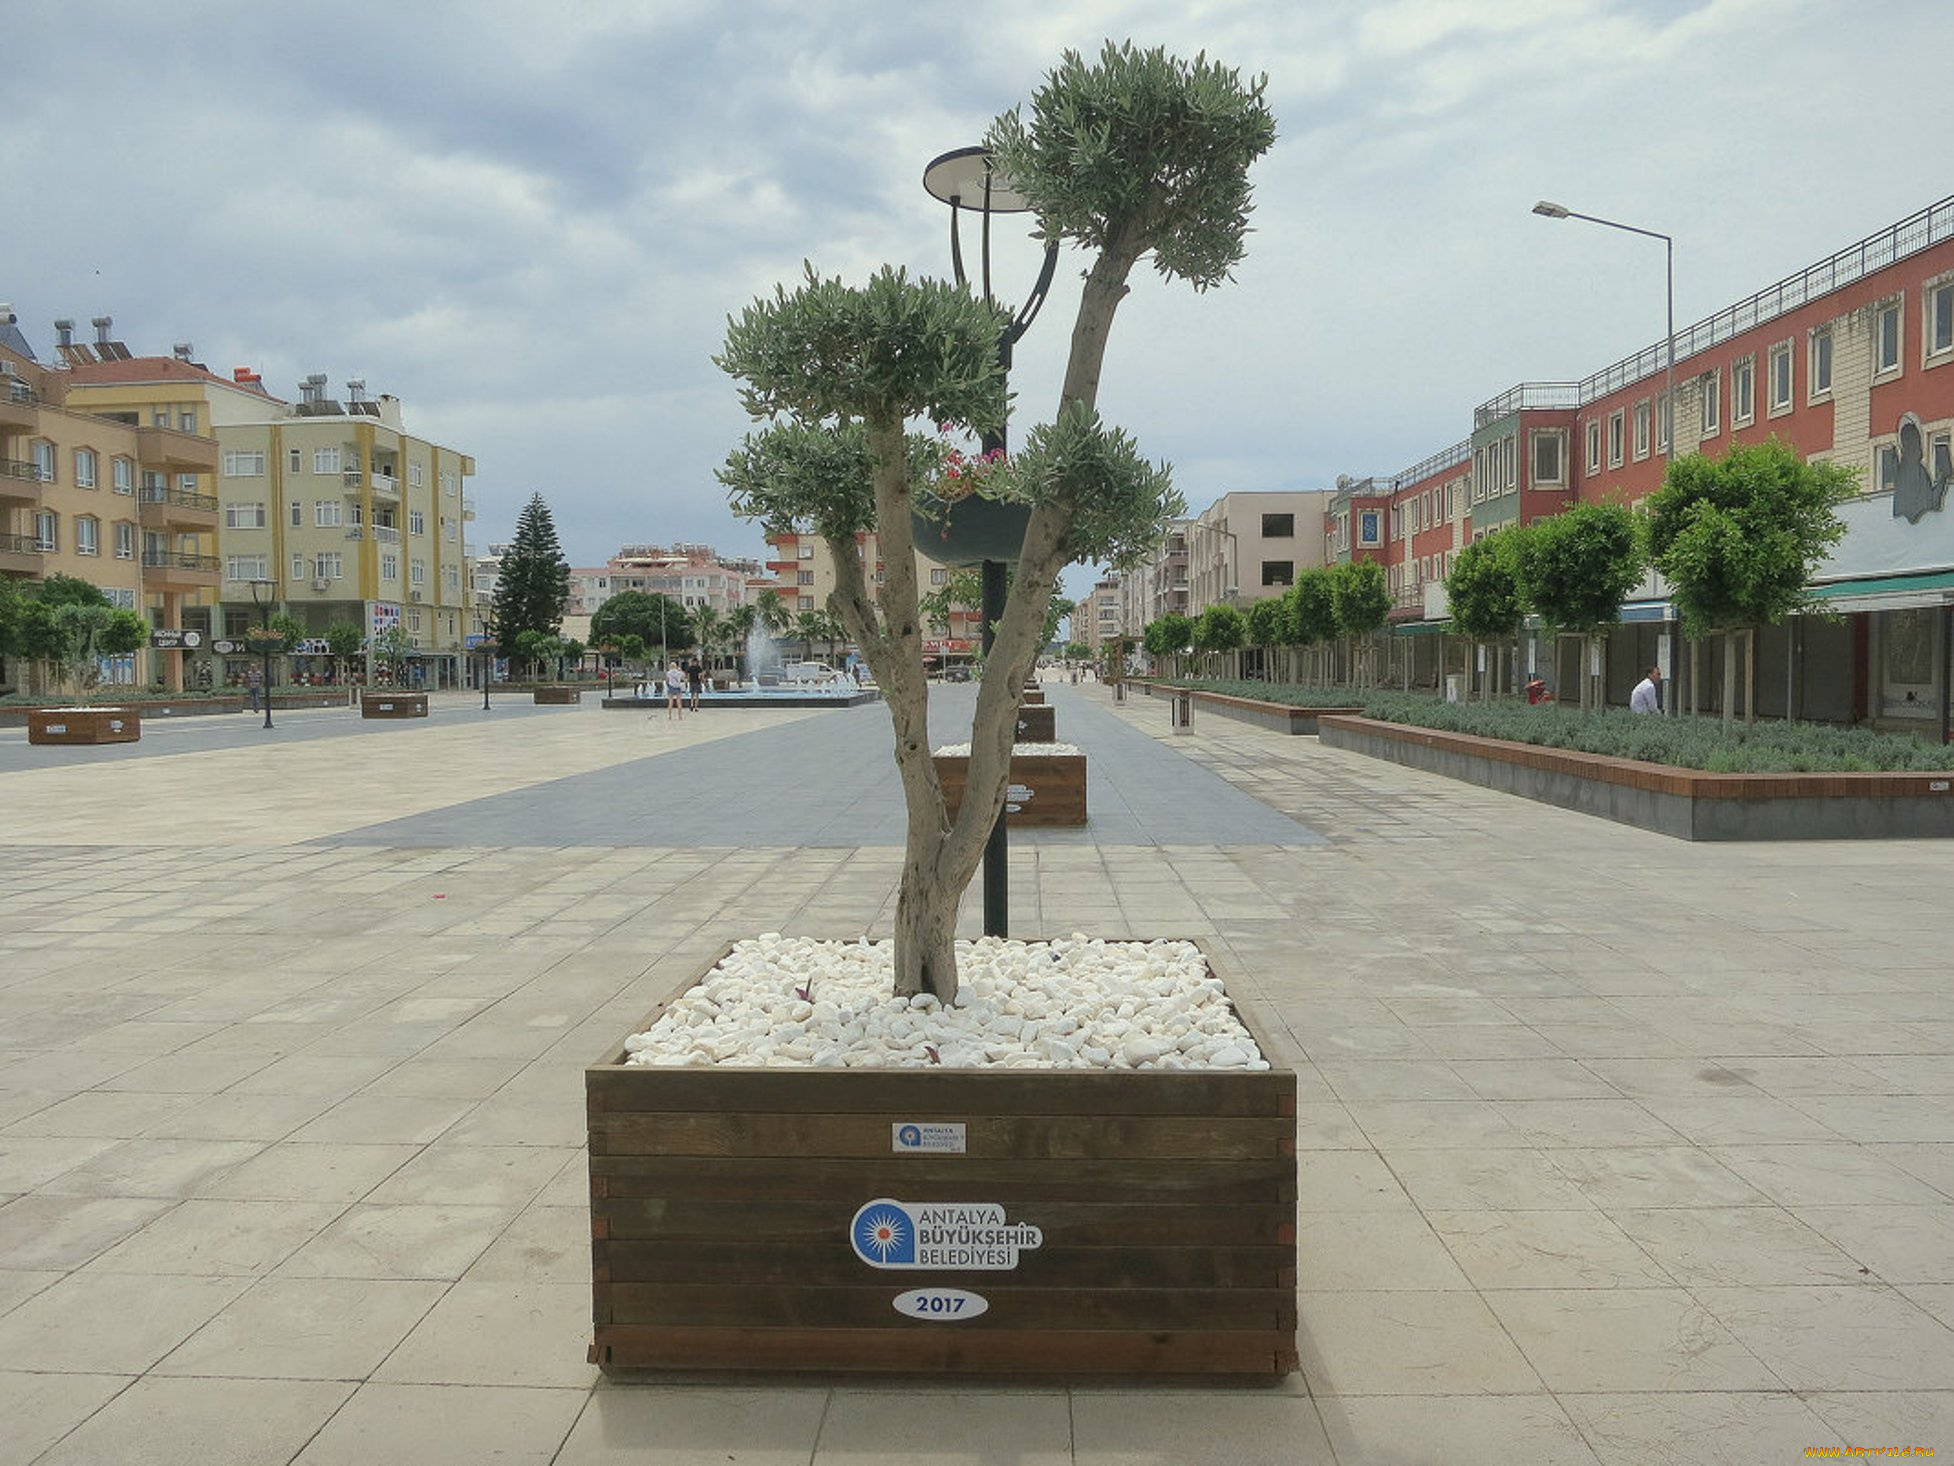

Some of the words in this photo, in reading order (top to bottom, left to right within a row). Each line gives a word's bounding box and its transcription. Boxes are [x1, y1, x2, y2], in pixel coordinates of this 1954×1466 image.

[919, 1209, 1000, 1225] ANTALYA
[919, 1225, 1037, 1248] BÜYÜKŞEHİR
[920, 1247, 1011, 1265] BELEDİYESİ
[916, 1297, 966, 1313] 2017
